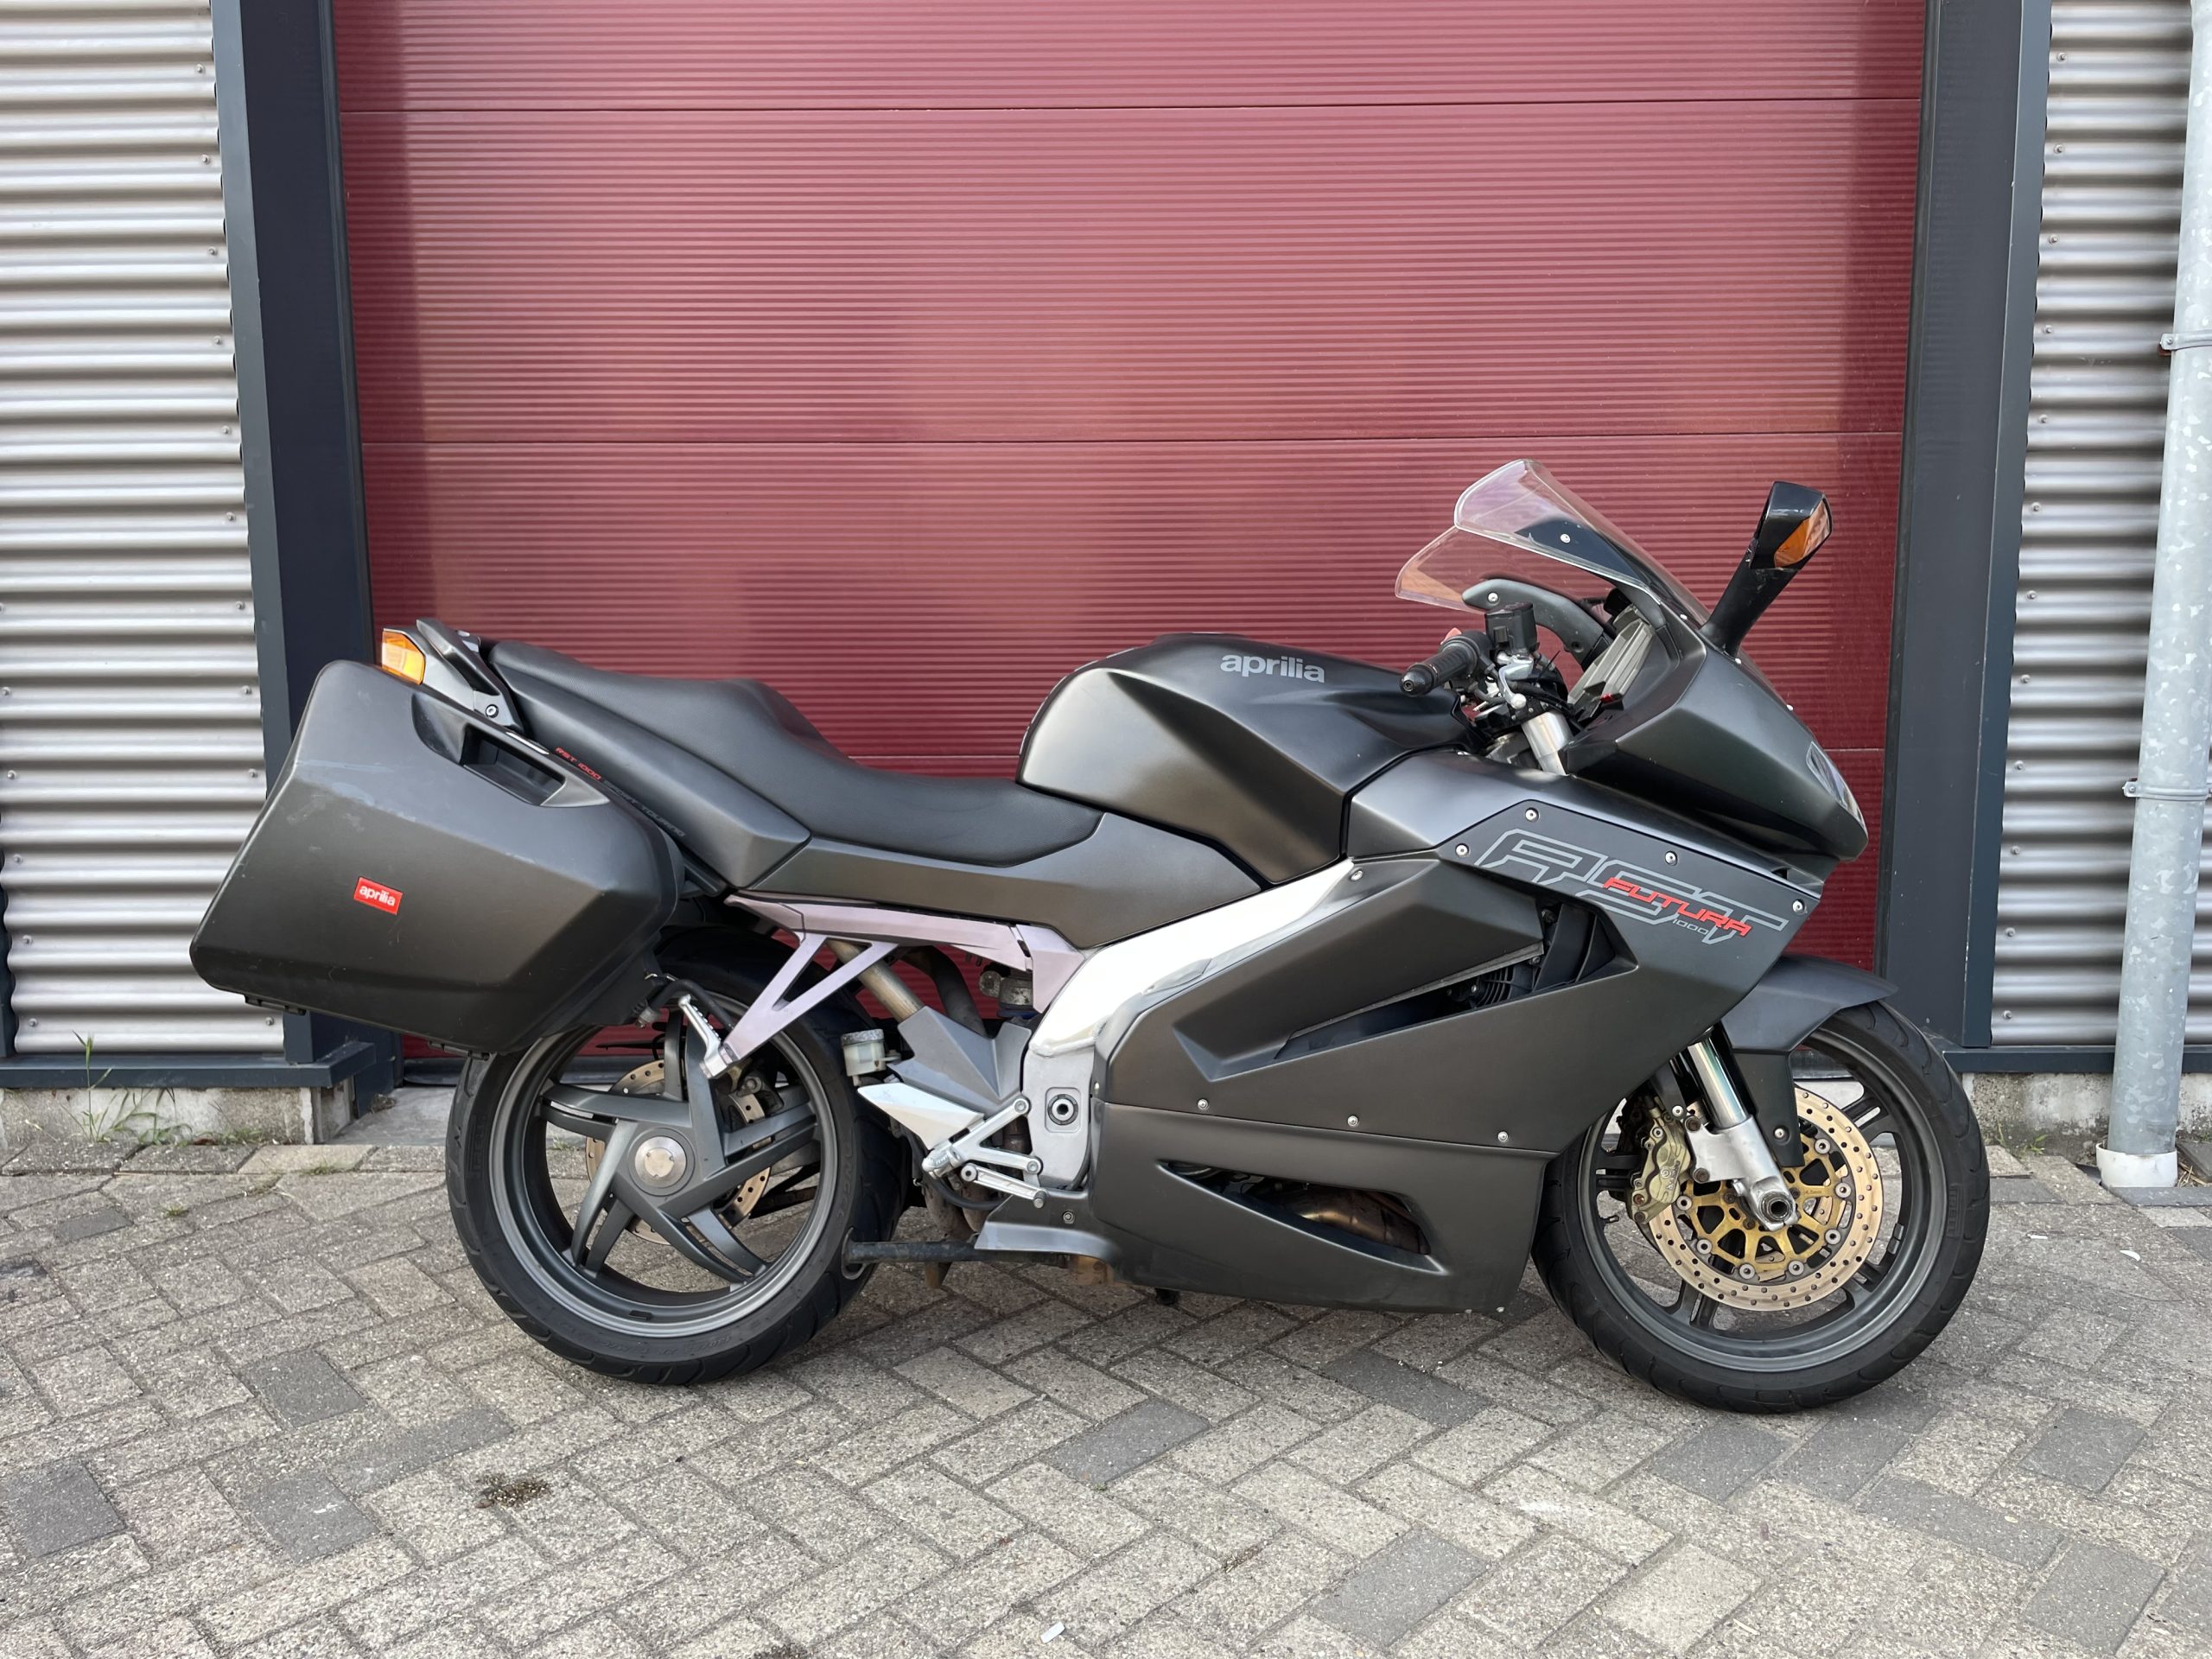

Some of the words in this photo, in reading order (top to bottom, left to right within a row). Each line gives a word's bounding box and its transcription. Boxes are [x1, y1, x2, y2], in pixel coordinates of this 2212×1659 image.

[1220, 654, 1325, 683] aprilia
[555, 747, 578, 762] RST
[578, 762, 602, 780] 1000
[359, 885, 397, 907] aprilia
[1603, 877, 1752, 937] FUTURA
[1672, 918, 1709, 935] 1000
